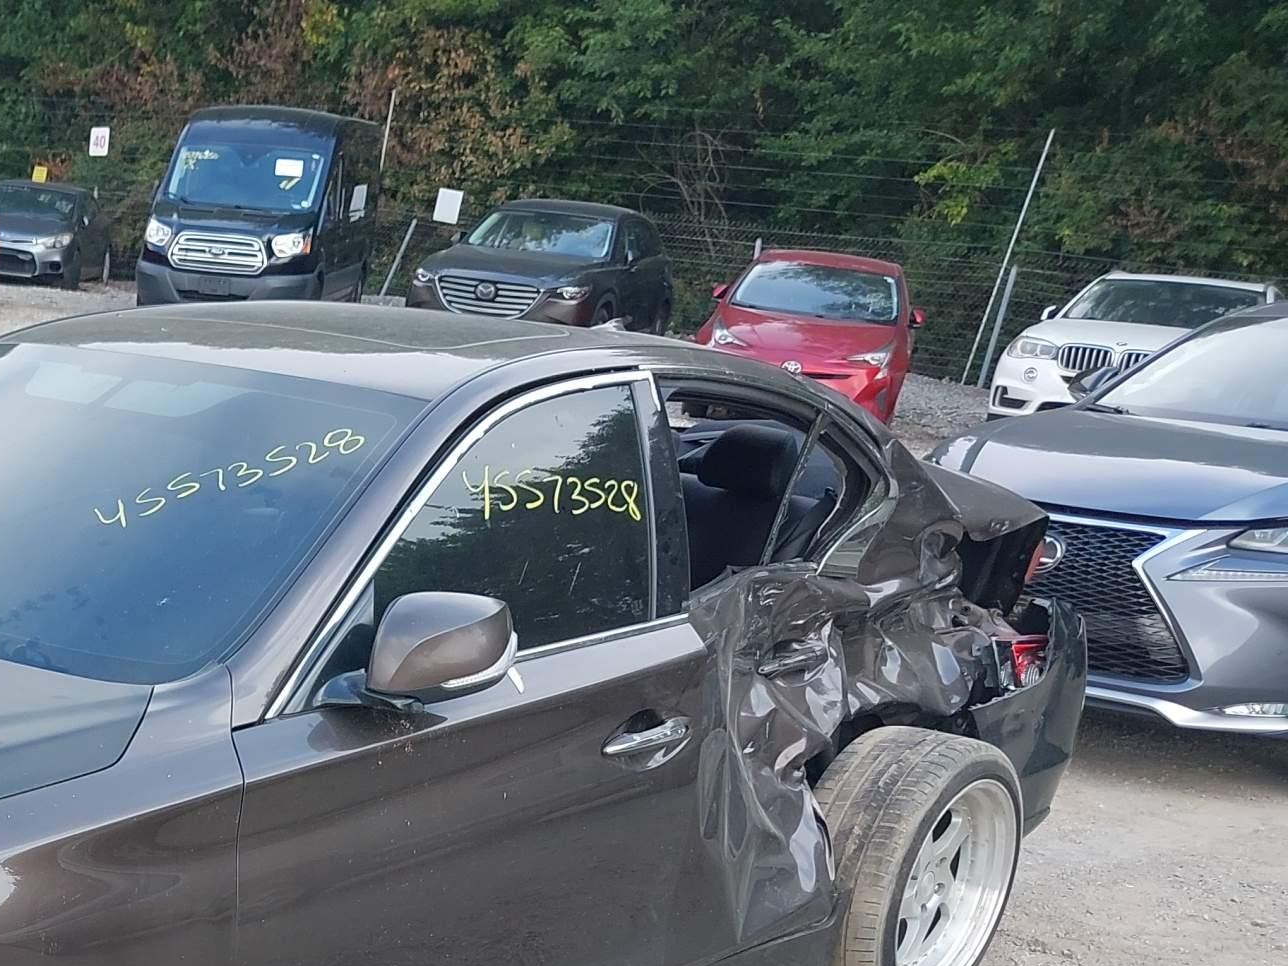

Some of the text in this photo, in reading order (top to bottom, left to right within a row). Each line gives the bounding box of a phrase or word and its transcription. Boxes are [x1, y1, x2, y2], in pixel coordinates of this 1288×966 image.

[93, 135, 106, 150] 40
[94, 428, 365, 528] 45573528
[462, 465, 641, 521] 45573528
